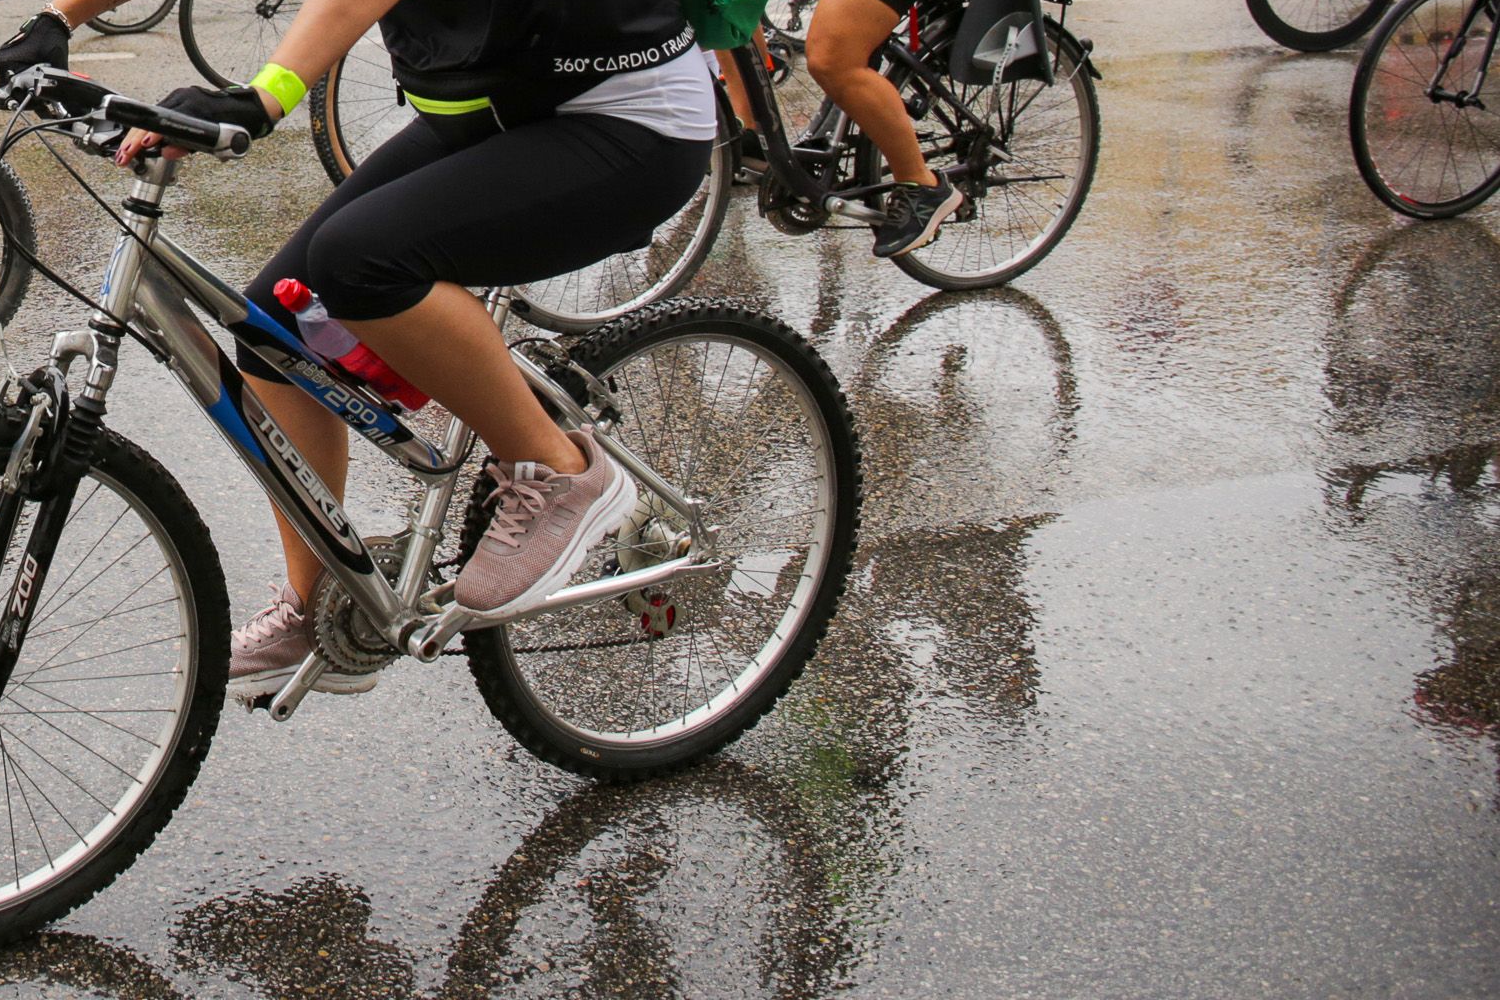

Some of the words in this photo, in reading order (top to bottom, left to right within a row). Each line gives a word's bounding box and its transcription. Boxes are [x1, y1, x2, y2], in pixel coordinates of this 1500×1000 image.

[593, 47, 660, 72] CARDIO
[324, 385, 378, 425] 200
[258, 410, 345, 532] TOPBIKE
